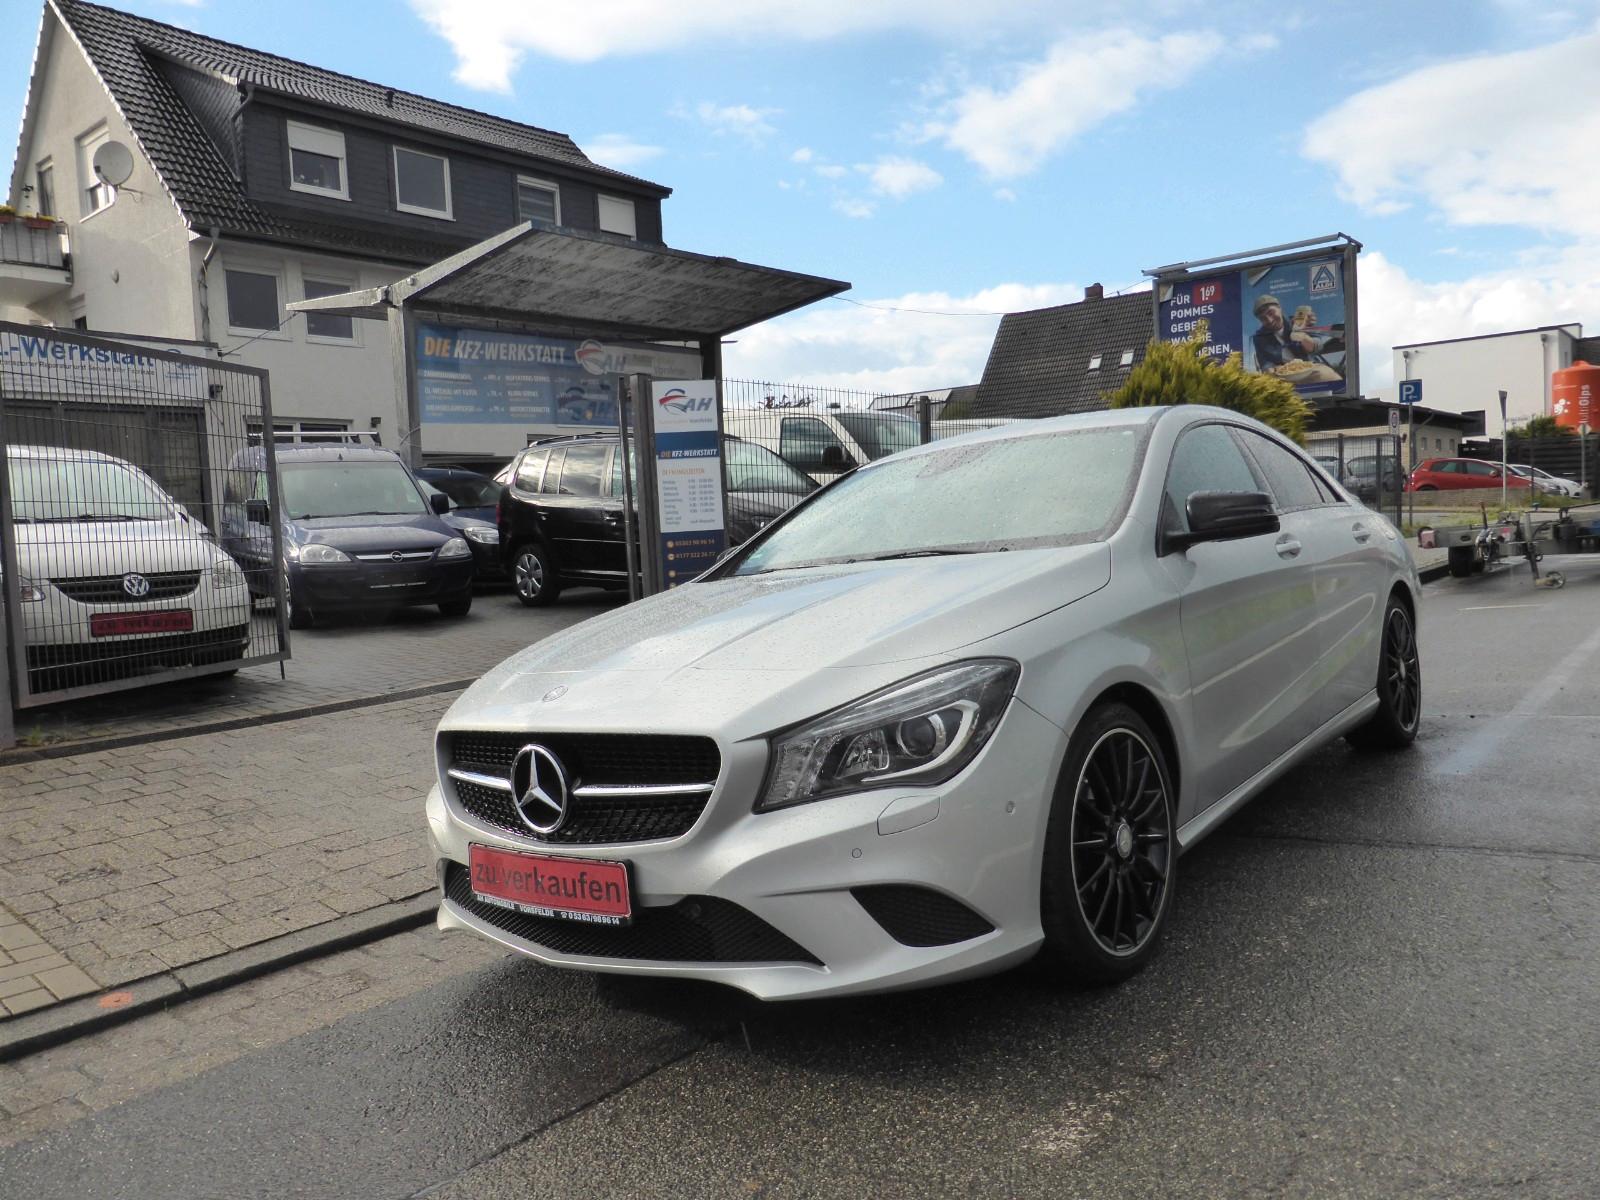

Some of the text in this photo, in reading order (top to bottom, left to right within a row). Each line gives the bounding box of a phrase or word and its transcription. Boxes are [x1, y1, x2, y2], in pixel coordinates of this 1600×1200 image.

[1170, 294, 1190, 306] FÜR
[1170, 305, 1214, 320] POMMES
[1170, 321, 1208, 333] GEBE,
[424, 336, 566, 364] DIE KFZ-WERKSTATT
[1402, 385, 1415, 401] P
[686, 397, 713, 411] AH
[672, 448, 717, 458] KFZ-WERKSTATT
[475, 863, 622, 904] zu verkaufen
[519, 903, 555, 917] VORSFELDE
